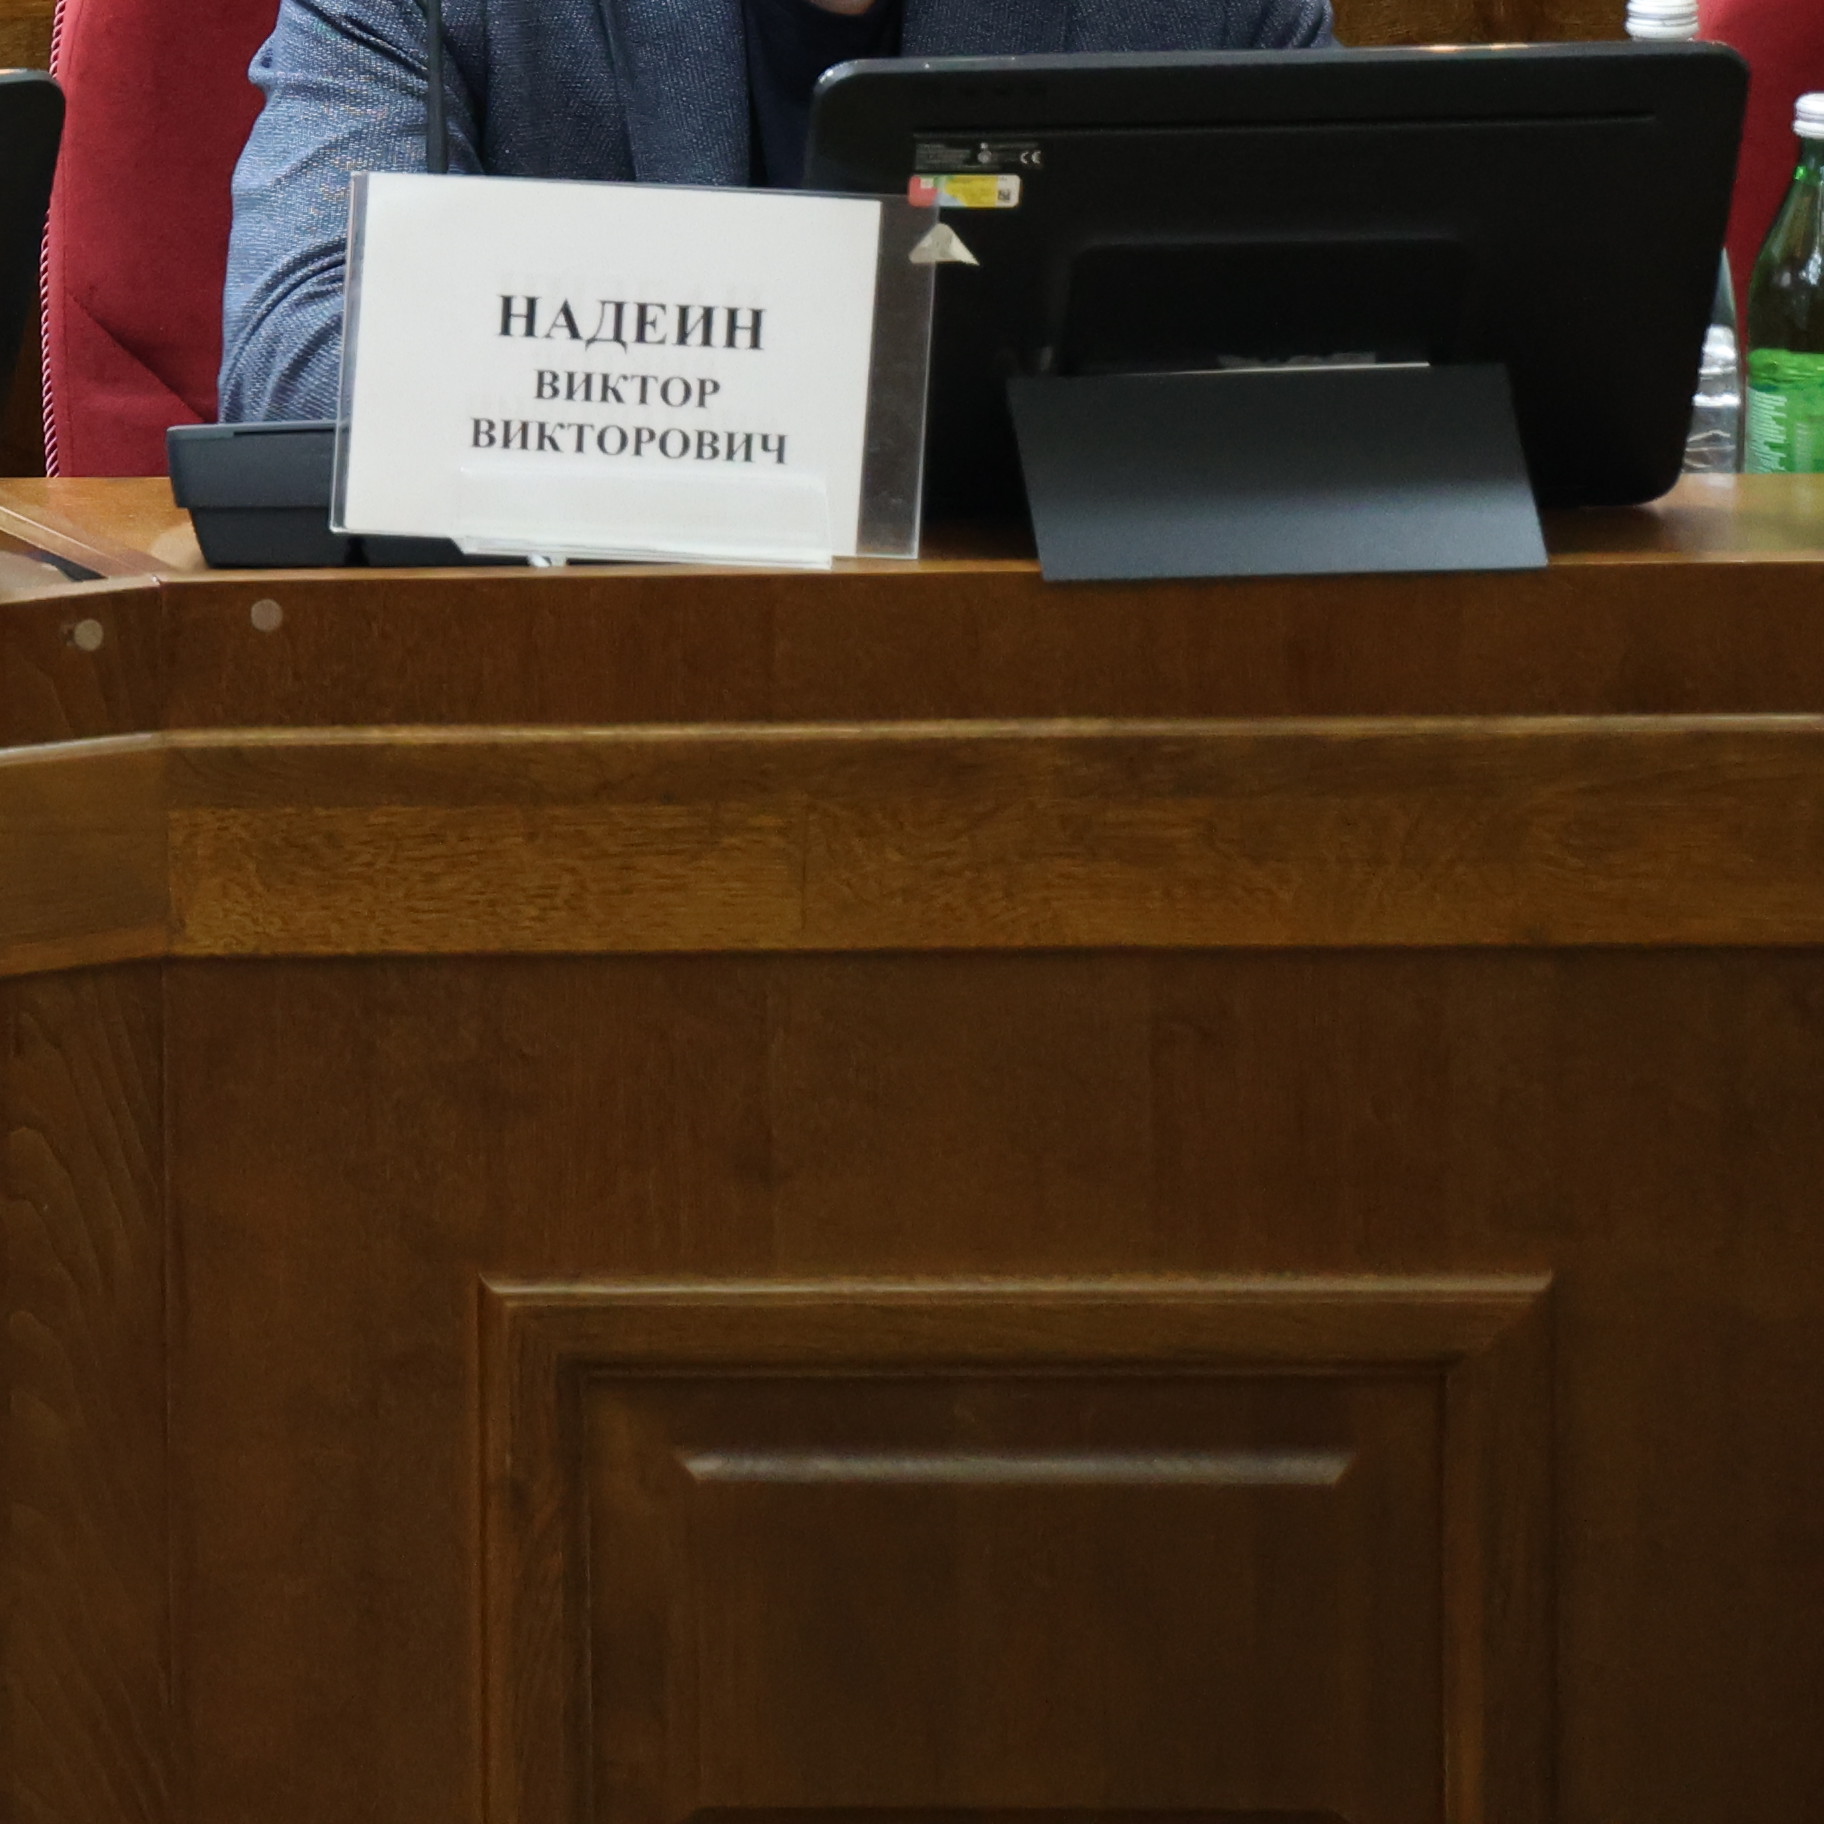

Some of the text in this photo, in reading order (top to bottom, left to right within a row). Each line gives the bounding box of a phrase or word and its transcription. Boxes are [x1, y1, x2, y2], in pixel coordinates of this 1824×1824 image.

[497, 294, 767, 354] НАДЕИН
[534, 369, 721, 408] ВИКТОР
[470, 417, 788, 465] ВИКТОРОВИЧ
